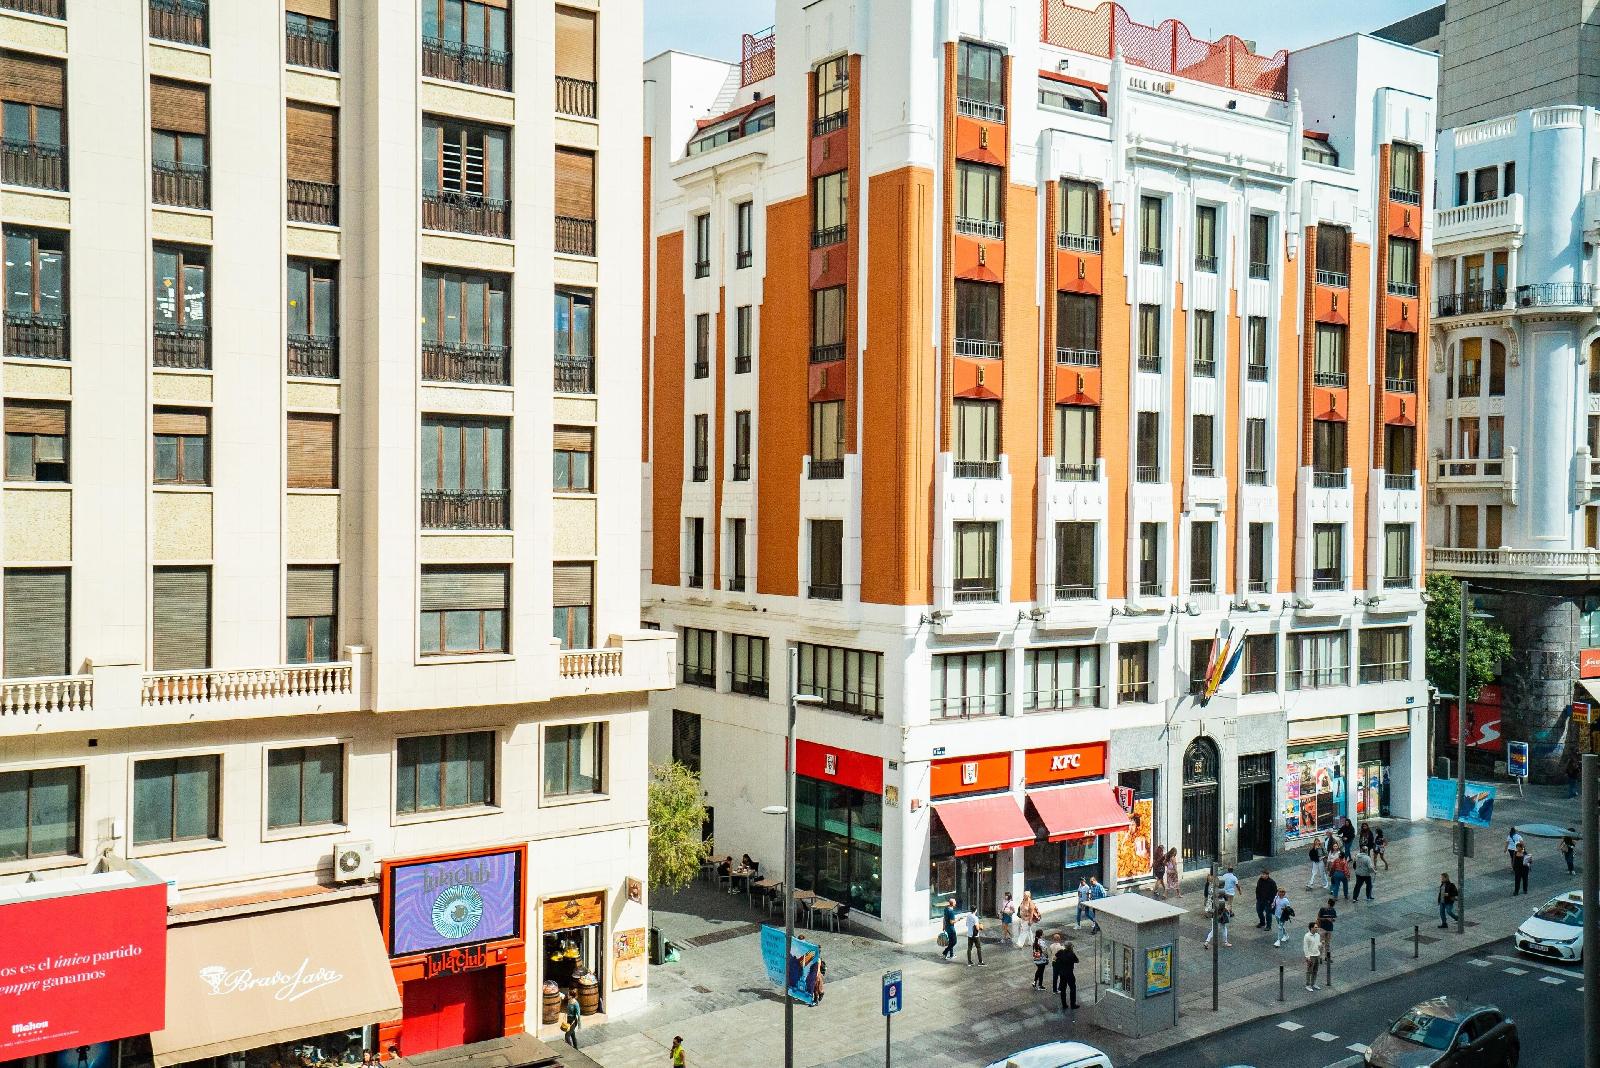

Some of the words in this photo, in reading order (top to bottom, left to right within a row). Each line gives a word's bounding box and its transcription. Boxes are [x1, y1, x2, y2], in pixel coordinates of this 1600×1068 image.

[1051, 753, 1080, 770] KFC
[988, 844, 1002, 852] KFC
[20, 964, 35, 974] es
[38, 957, 51, 971] el
[54, 953, 91, 968] único
[92, 944, 143, 965] partido
[42, 969, 106, 991] ganamos
[11, 1020, 49, 1035] Mahou
